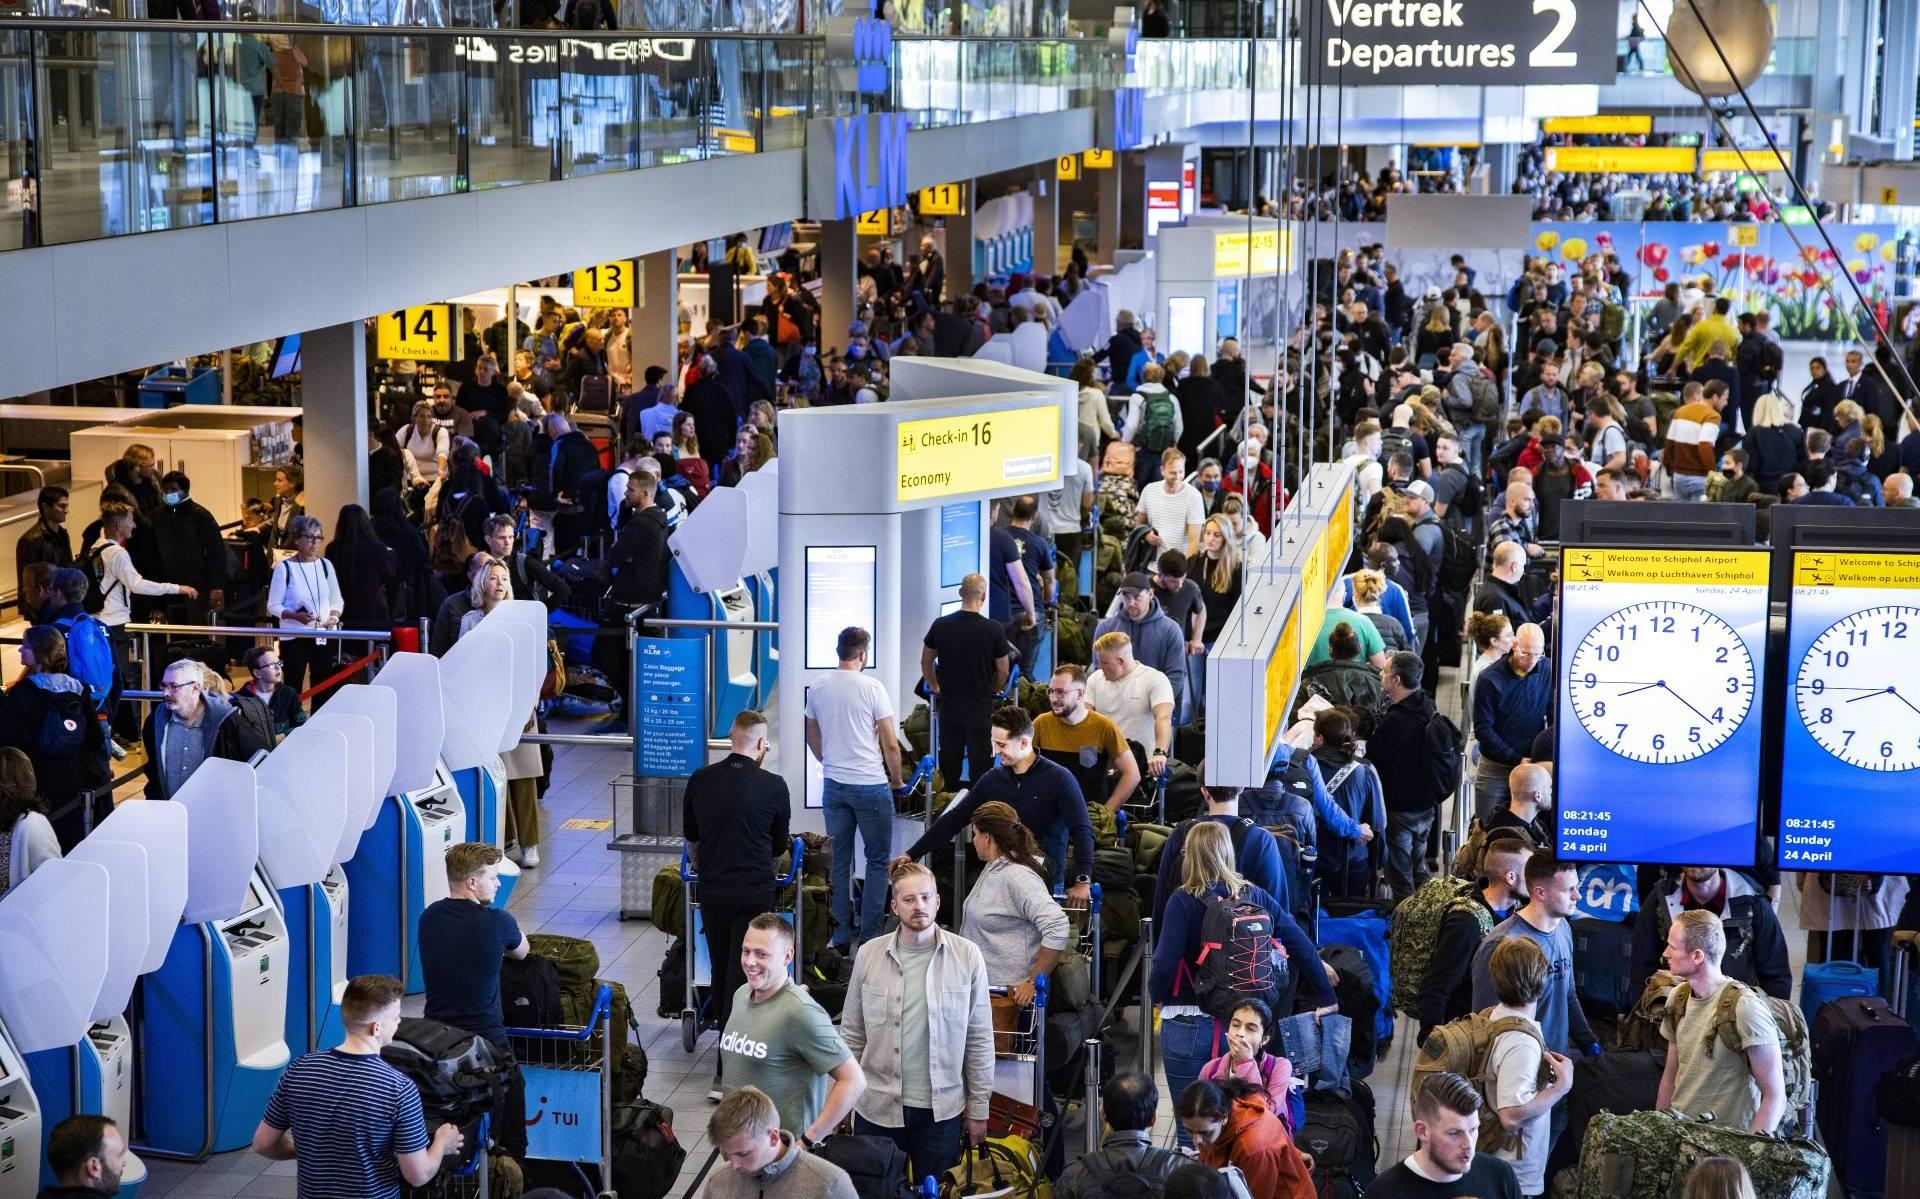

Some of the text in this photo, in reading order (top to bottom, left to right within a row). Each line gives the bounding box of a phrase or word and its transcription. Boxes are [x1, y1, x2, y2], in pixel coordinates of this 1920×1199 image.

[1328, 0, 1464, 27] Vertrek
[1529, 0, 1578, 67] 2
[1327, 38, 1515, 74] Departures
[836, 112, 907, 220] KLM
[928, 186, 950, 205] 11
[585, 264, 622, 292] 13
[391, 309, 437, 342] 14
[403, 347, 439, 356] Check-in
[921, 421, 992, 447] Check-in 16
[901, 471, 951, 488] Economy
[1608, 554, 1738, 565] Welcome to Schiphol Airport
[1840, 558, 1920, 568] Welcome to Schip
[1607, 569, 1754, 580] Welkom op Luchthaven Schiphol
[1838, 574, 1920, 584] Welkom op Lucht
[1694, 586, 1727, 595] Sunday,
[1741, 587, 1763, 595] April
[1616, 624, 1637, 641] 11
[1650, 616, 1675, 633] 12
[1881, 621, 1908, 639] 12
[1691, 626, 1700, 643] 1
[1846, 629, 1868, 646] 11
[1594, 645, 1620, 662] 10
[1715, 647, 1729, 663] 2
[1823, 650, 1849, 668] 10
[1584, 673, 1597, 689] 9
[1726, 677, 1739, 693] 3
[1812, 678, 1825, 695] 9
[1593, 701, 1606, 717] 8
[1711, 707, 1724, 723] 4
[1820, 707, 1833, 724] 8
[1615, 724, 1628, 739] 7
[1688, 727, 1701, 743] 5
[1842, 730, 1856, 746] 7
[1652, 734, 1665, 750] 6
[1880, 741, 1893, 757] 6
[1563, 810, 1611, 821] 08:21:45
[1785, 818, 1836, 829] 08:21:45
[1563, 827, 1608, 839] zondag
[1785, 835, 1832, 847] Sunday
[1562, 842, 1607, 854] 24 april
[1784, 850, 1832, 862] 24 April
[551, 1111, 578, 1126] TUI
